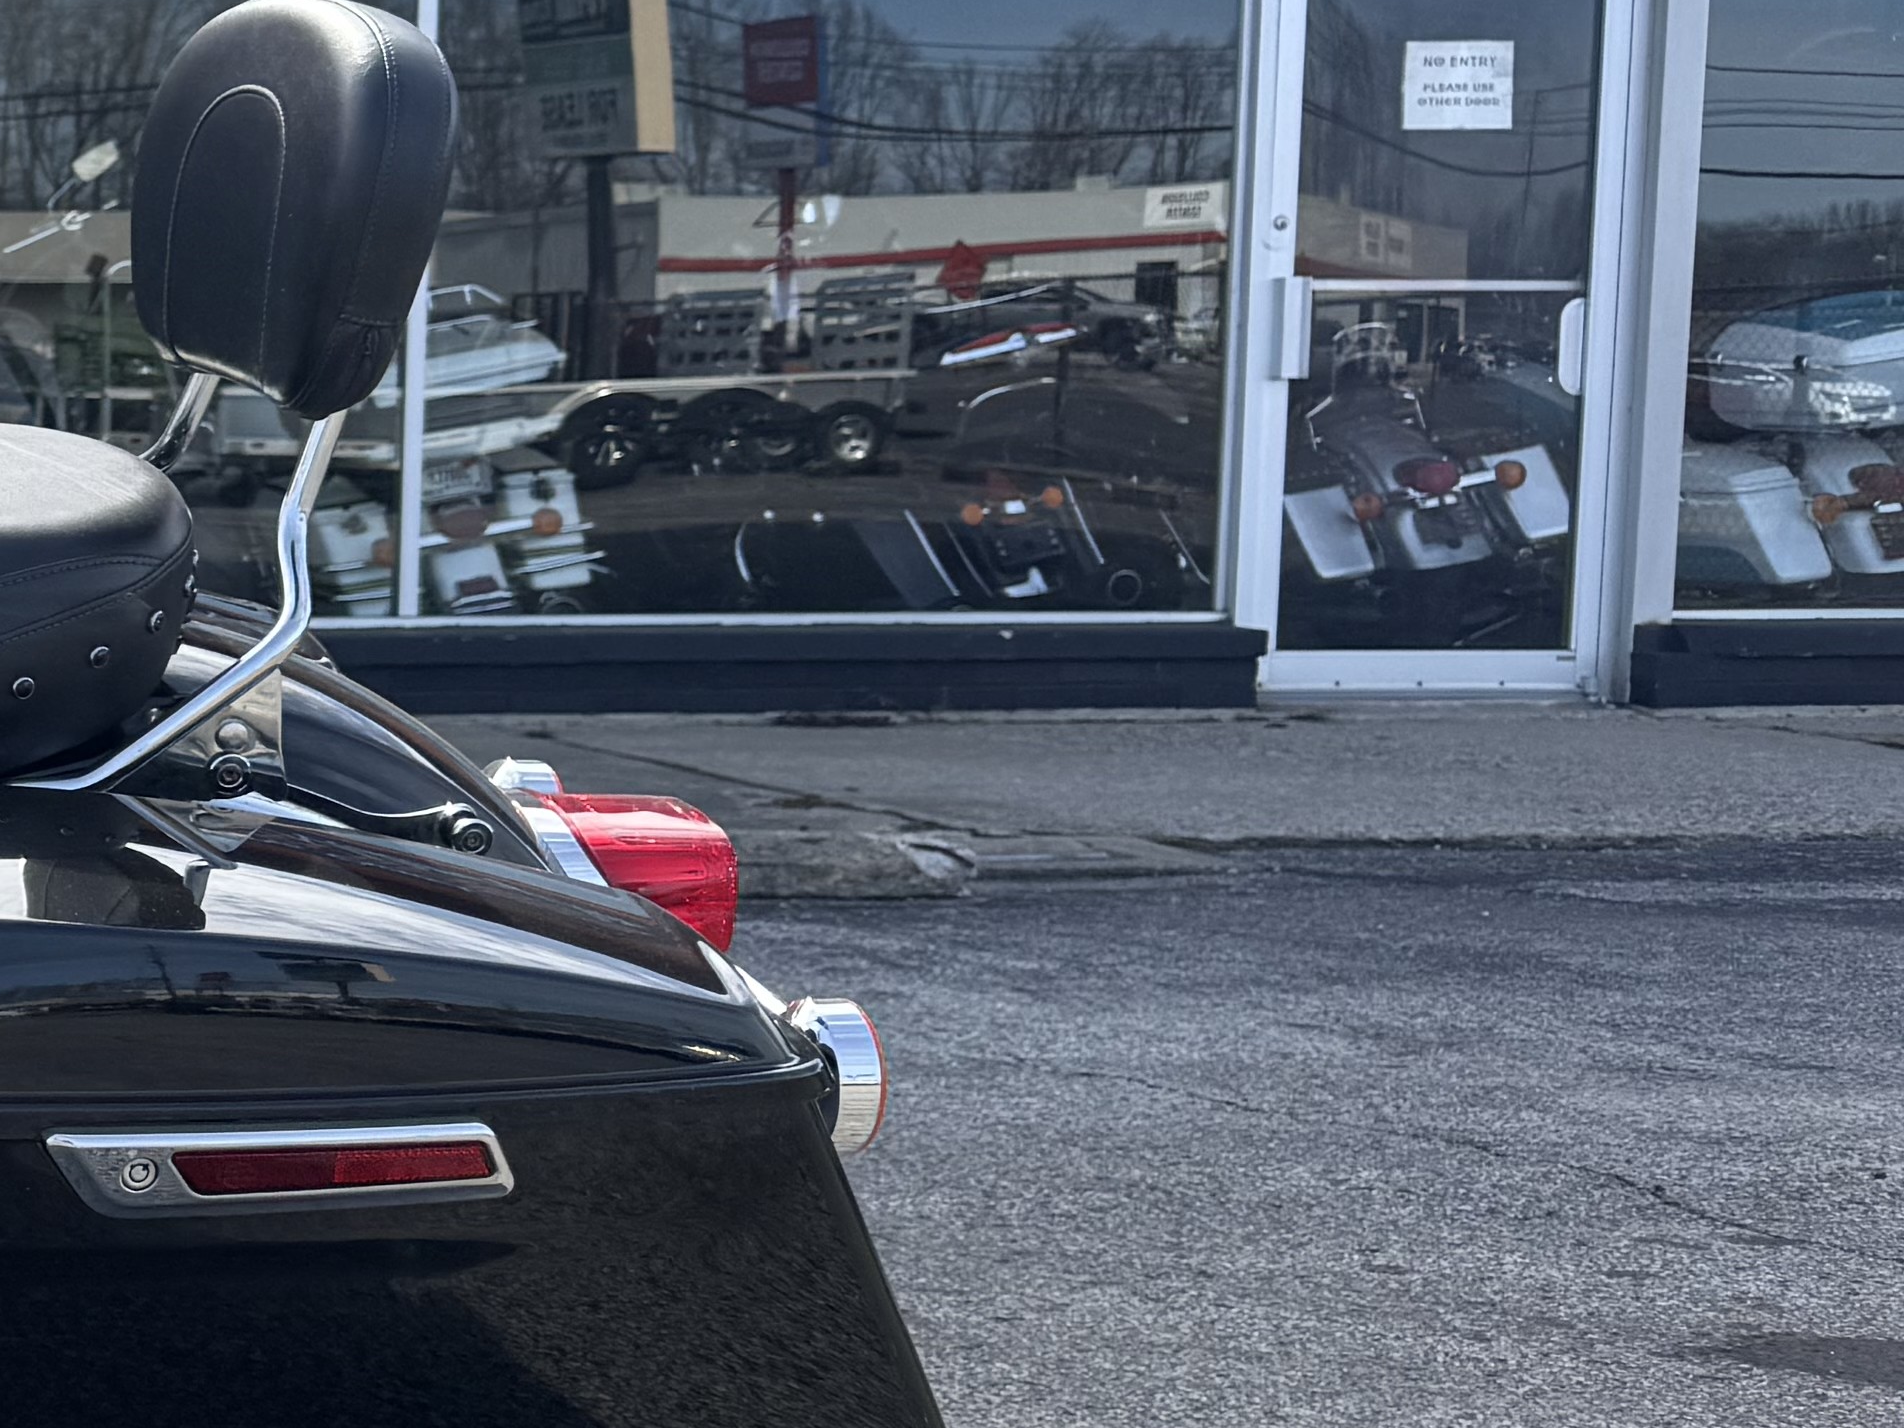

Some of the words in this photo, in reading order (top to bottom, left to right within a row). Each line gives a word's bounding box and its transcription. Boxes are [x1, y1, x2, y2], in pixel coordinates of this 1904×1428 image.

[1422, 55, 1446, 68] NO
[1449, 55, 1498, 68] ENTRY
[1422, 82, 1469, 93] PLEASE
[1416, 96, 1462, 107] OTHER
[1464, 96, 1501, 107] DOOR
